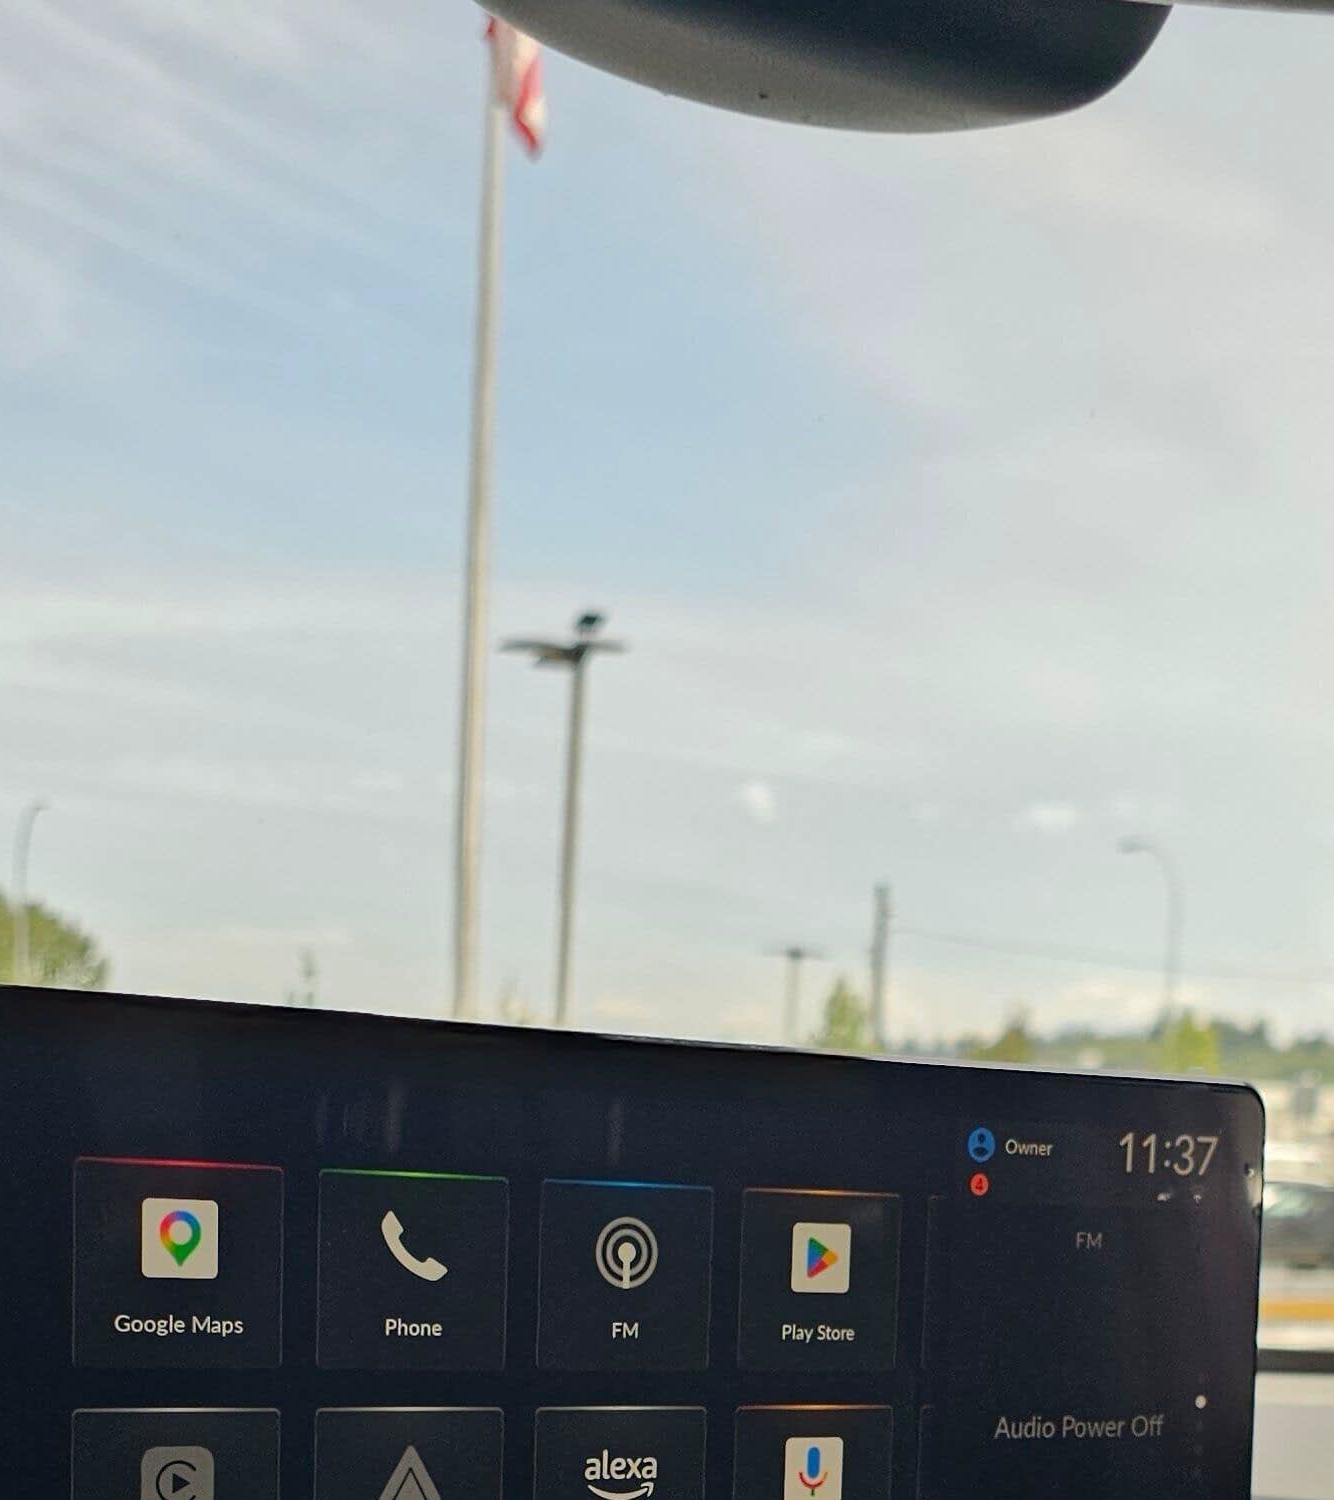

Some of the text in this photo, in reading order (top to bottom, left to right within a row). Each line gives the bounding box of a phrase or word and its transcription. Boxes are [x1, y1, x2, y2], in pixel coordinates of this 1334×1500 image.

[1005, 1139, 1053, 1156] Owner
[1120, 1133, 1218, 1175] 11:37
[1076, 1232, 1102, 1249] FM
[114, 1315, 243, 1337] Google Maps
[386, 1318, 442, 1336] Phone
[612, 1322, 638, 1338] FM
[782, 1324, 854, 1343] Play Store
[994, 1414, 1164, 1439] Audio Power Off
[585, 1450, 658, 1481] alexa
